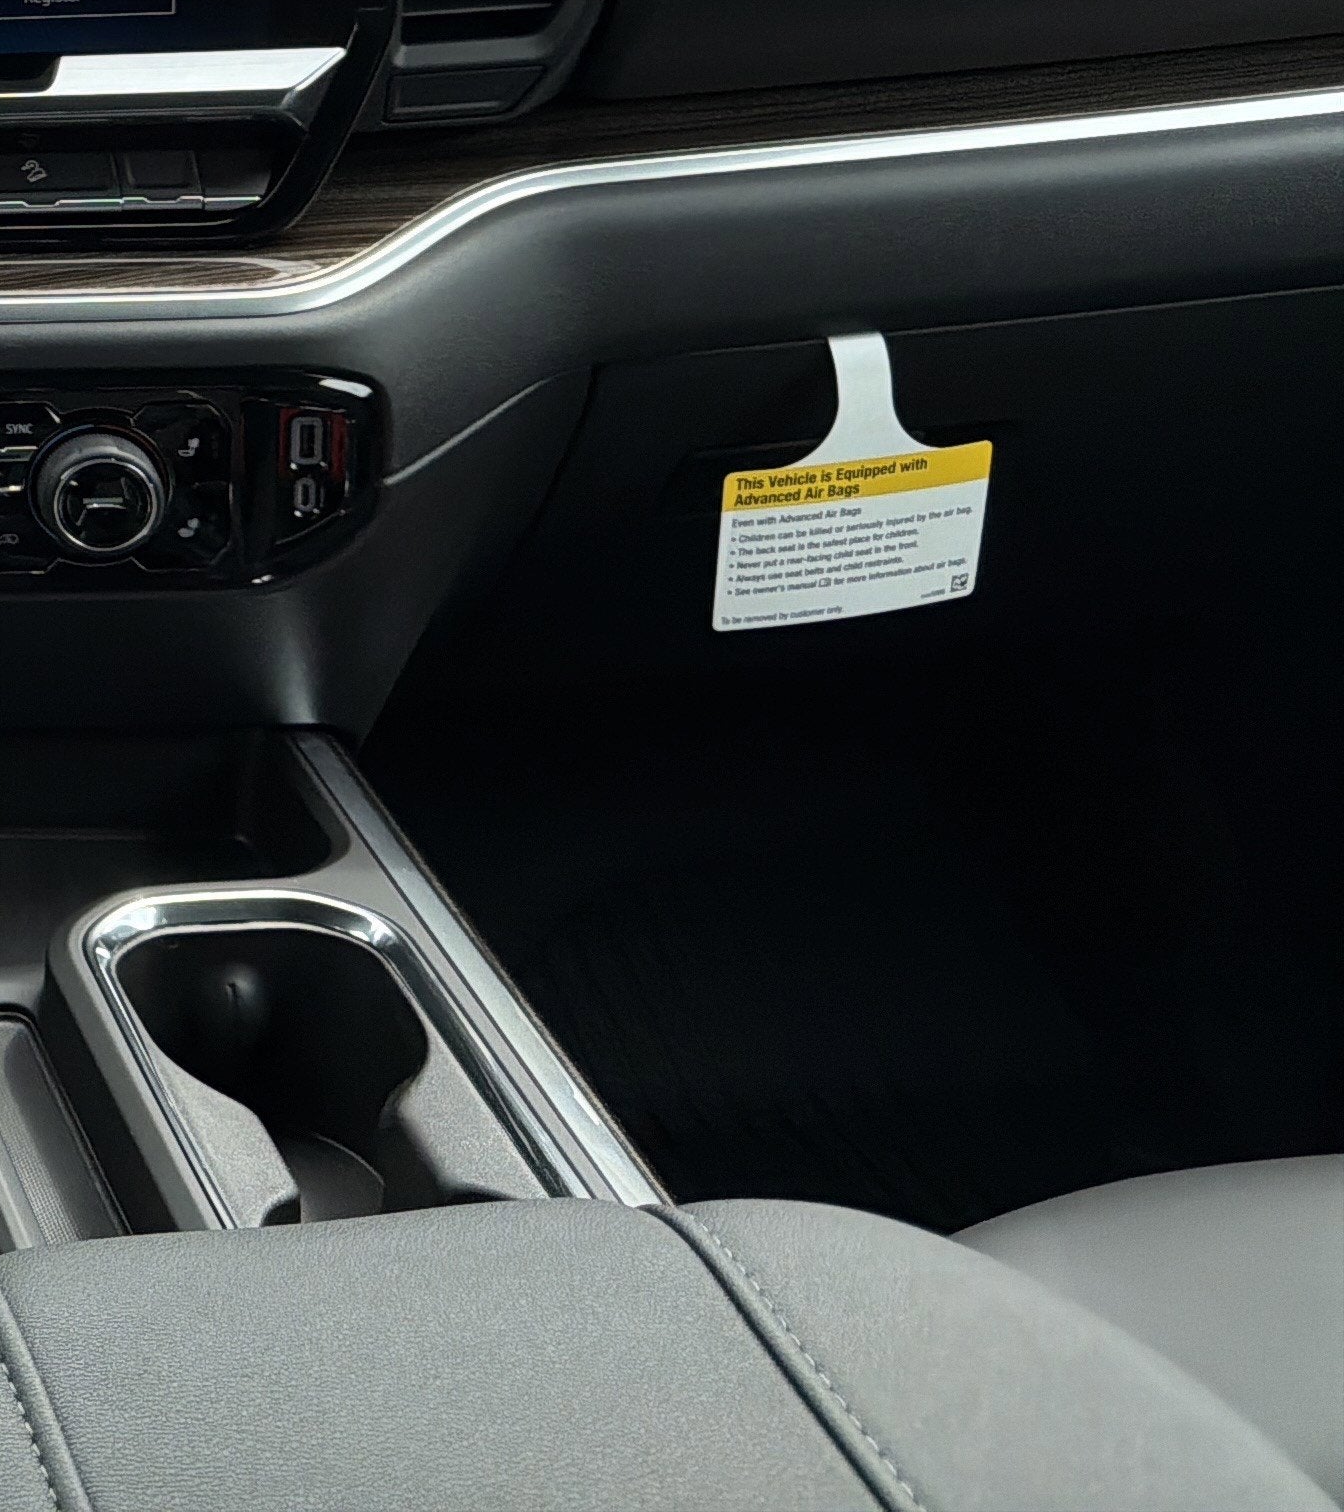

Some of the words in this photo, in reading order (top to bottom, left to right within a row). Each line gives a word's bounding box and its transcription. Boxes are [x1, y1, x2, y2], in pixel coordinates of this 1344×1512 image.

[5, 423, 34, 435] SYNC
[736, 476, 764, 491] This
[768, 472, 817, 488] Vehicle
[820, 470, 832, 483] is
[836, 461, 896, 482] Equipped
[899, 458, 928, 473] with
[734, 489, 801, 506] Advanced
[804, 486, 825, 501] Air
[827, 483, 860, 498] Bags
